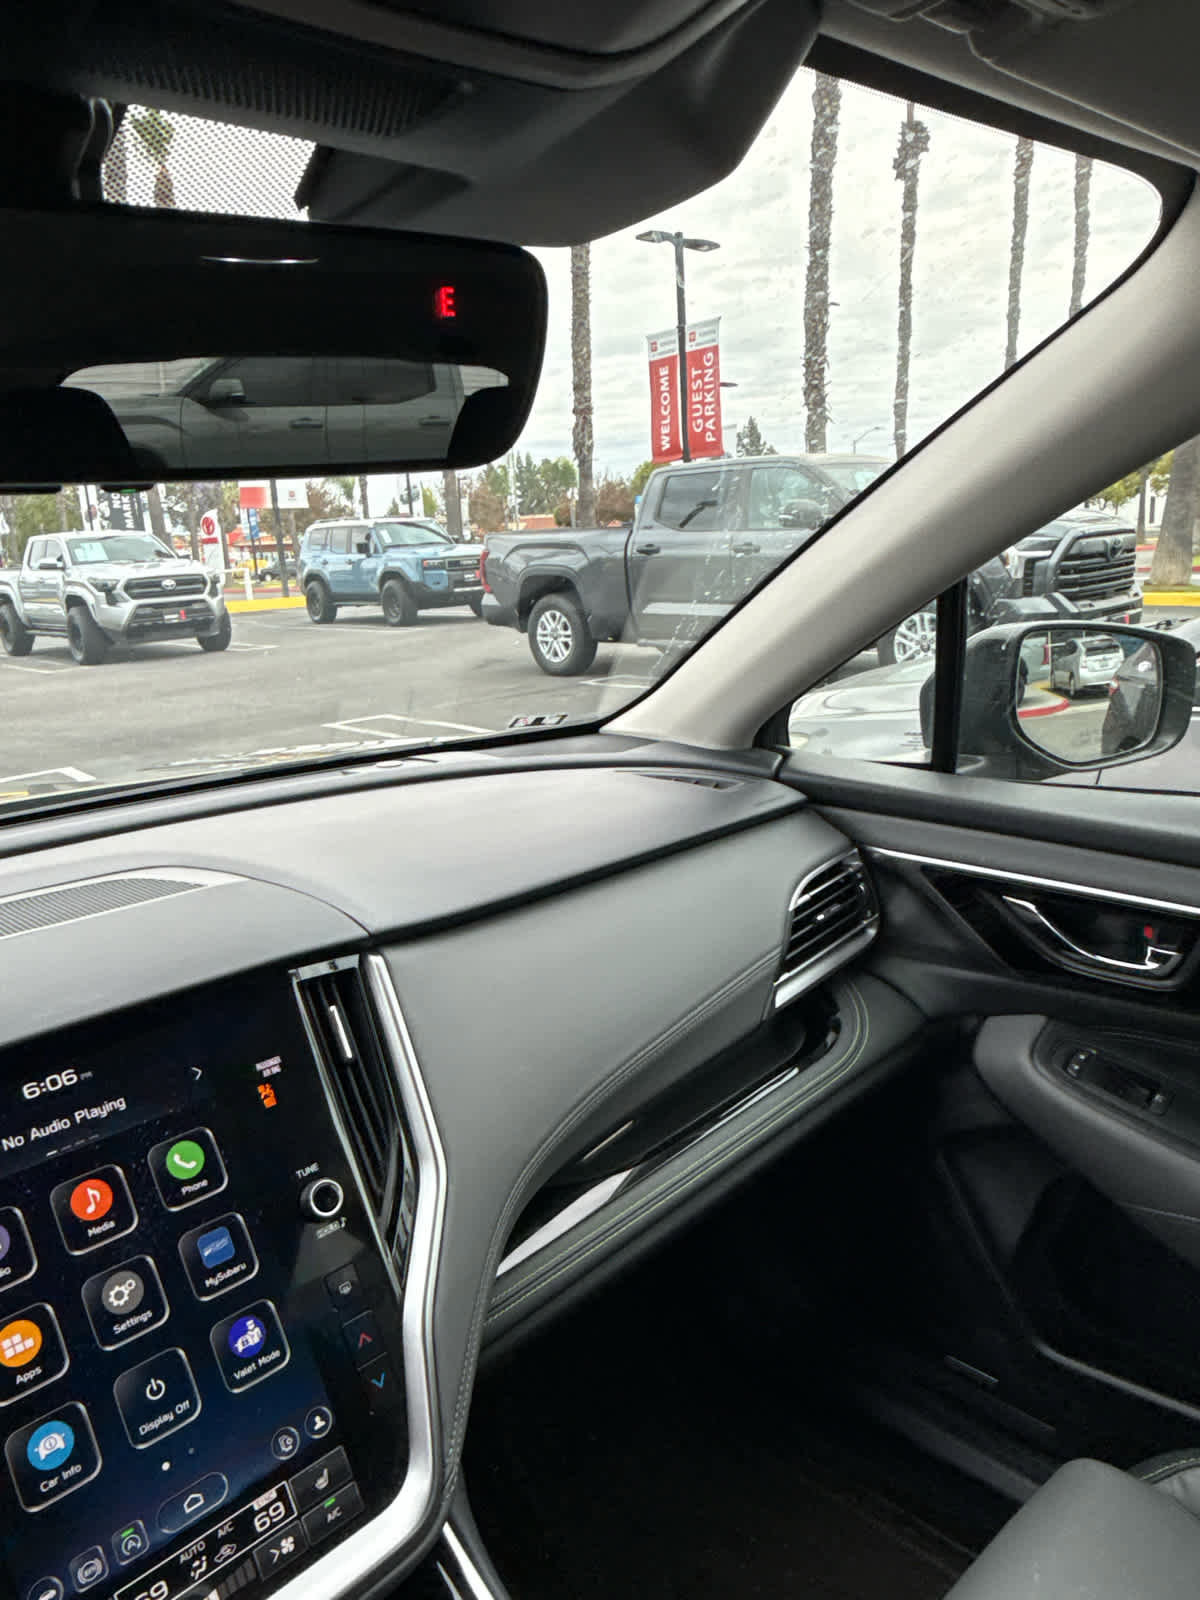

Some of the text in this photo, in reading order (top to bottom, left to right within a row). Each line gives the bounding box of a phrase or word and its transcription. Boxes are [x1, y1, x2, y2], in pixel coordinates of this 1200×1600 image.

[438, 286, 456, 317] E
[659, 365, 671, 452] WELCOME
[692, 367, 703, 433] GUEST
[704, 351, 717, 442] PARKING
[22, 1069, 78, 1099] 6:06
[1, 1097, 127, 1151] No Audio Playing
[295, 1162, 320, 1179] TUNE
[181, 1179, 209, 1195] Phone
[87, 1220, 116, 1237] Media
[205, 1262, 247, 1287] MySubaru
[113, 1310, 153, 1335] Settings
[16, 1366, 42, 1385] Apps
[233, 1349, 281, 1380] Valet Mode
[138, 1400, 190, 1435] Display Off
[40, 1464, 82, 1492] Car Info
[254, 1501, 286, 1532] 69
[326, 1506, 343, 1523] A/C
[217, 1521, 236, 1538] A/C
[179, 1540, 206, 1564] AUTO
